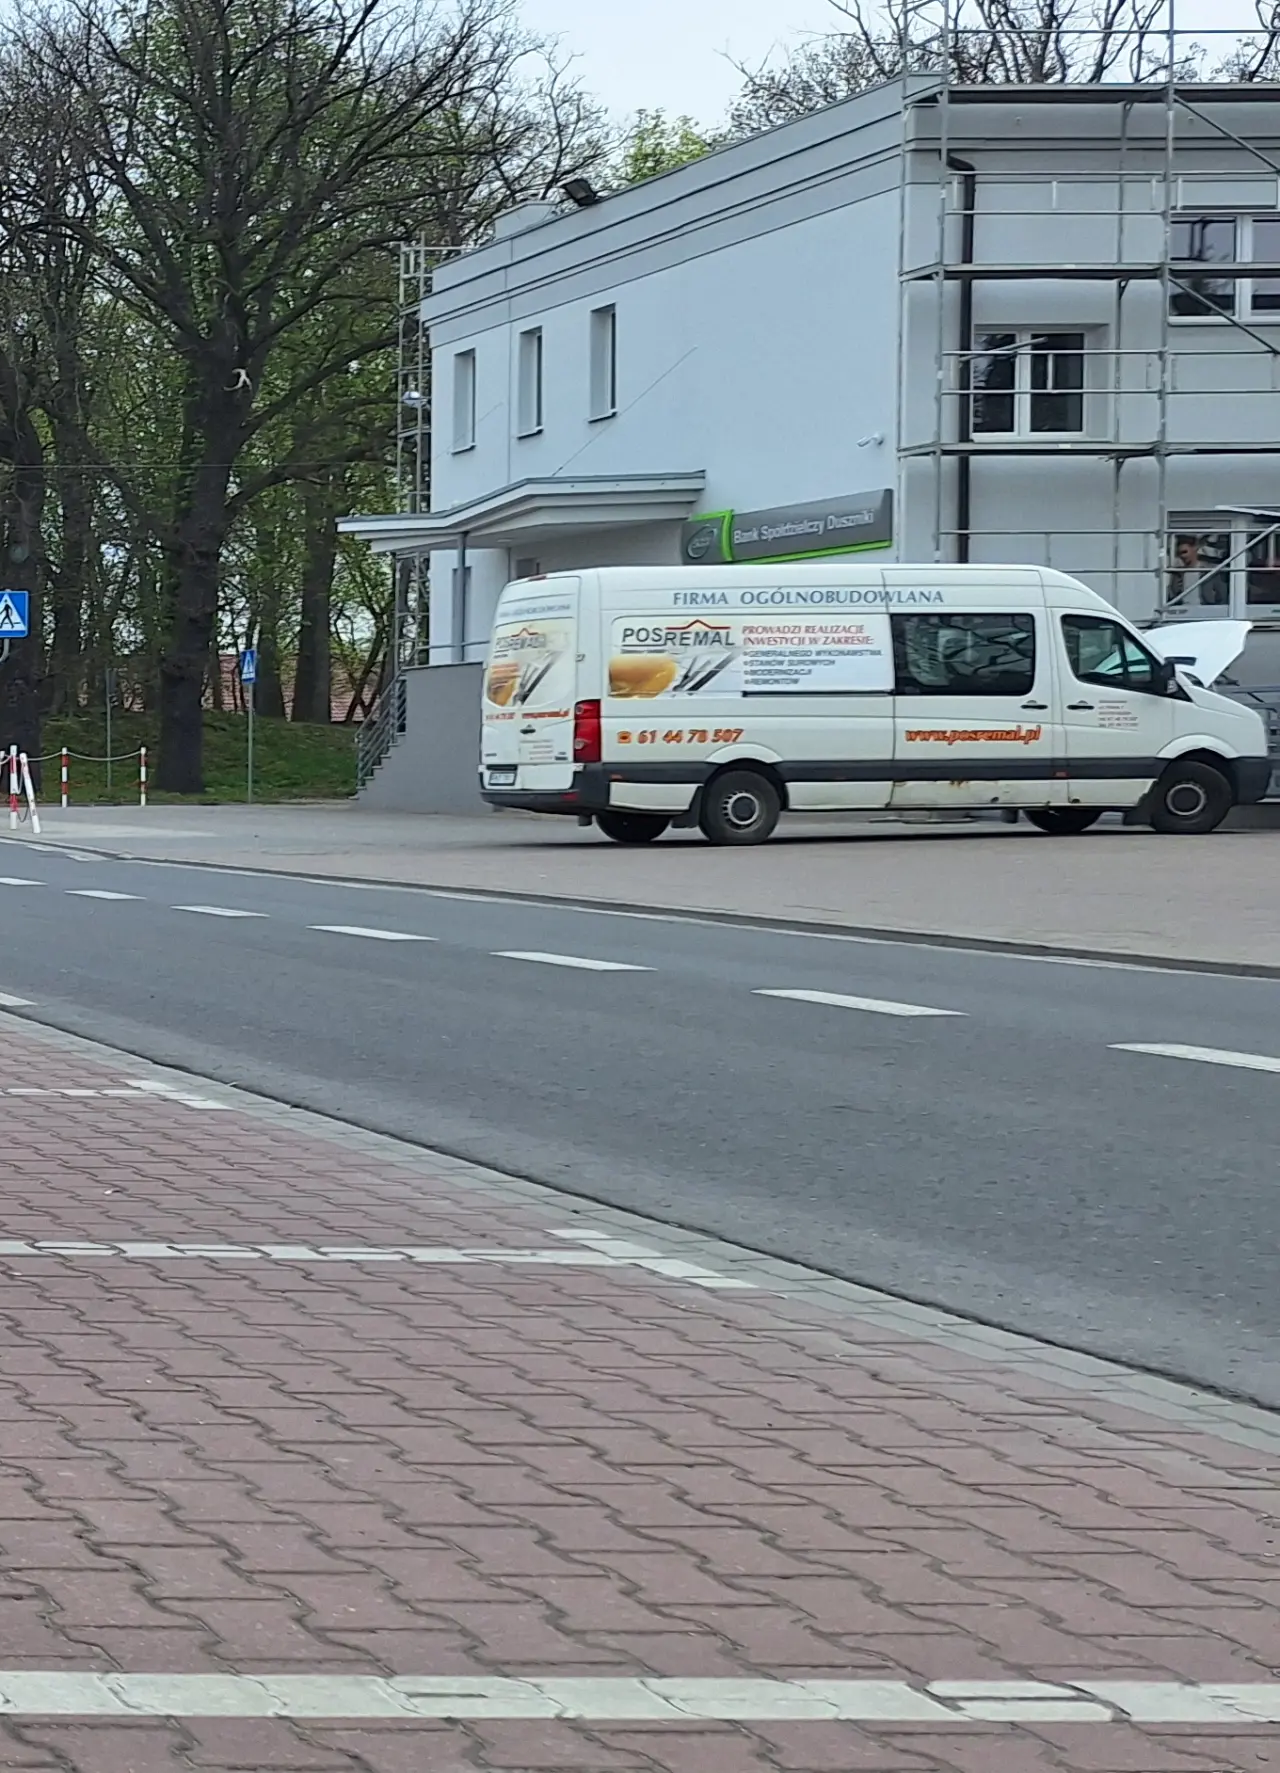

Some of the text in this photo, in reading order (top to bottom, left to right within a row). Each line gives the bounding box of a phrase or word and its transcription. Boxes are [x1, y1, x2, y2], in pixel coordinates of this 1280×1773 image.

[733, 527, 760, 544] Bank
[827, 509, 874, 530] Duszniki
[673, 588, 945, 605] FIRMA OGÓLNOBUDOWLANA
[742, 625, 865, 635] PROWADZI REALIZACJE
[743, 636, 806, 646] INWESTYCJI
[637, 730, 657, 744] 61
[905, 724, 1042, 746] www.posremal.pl
